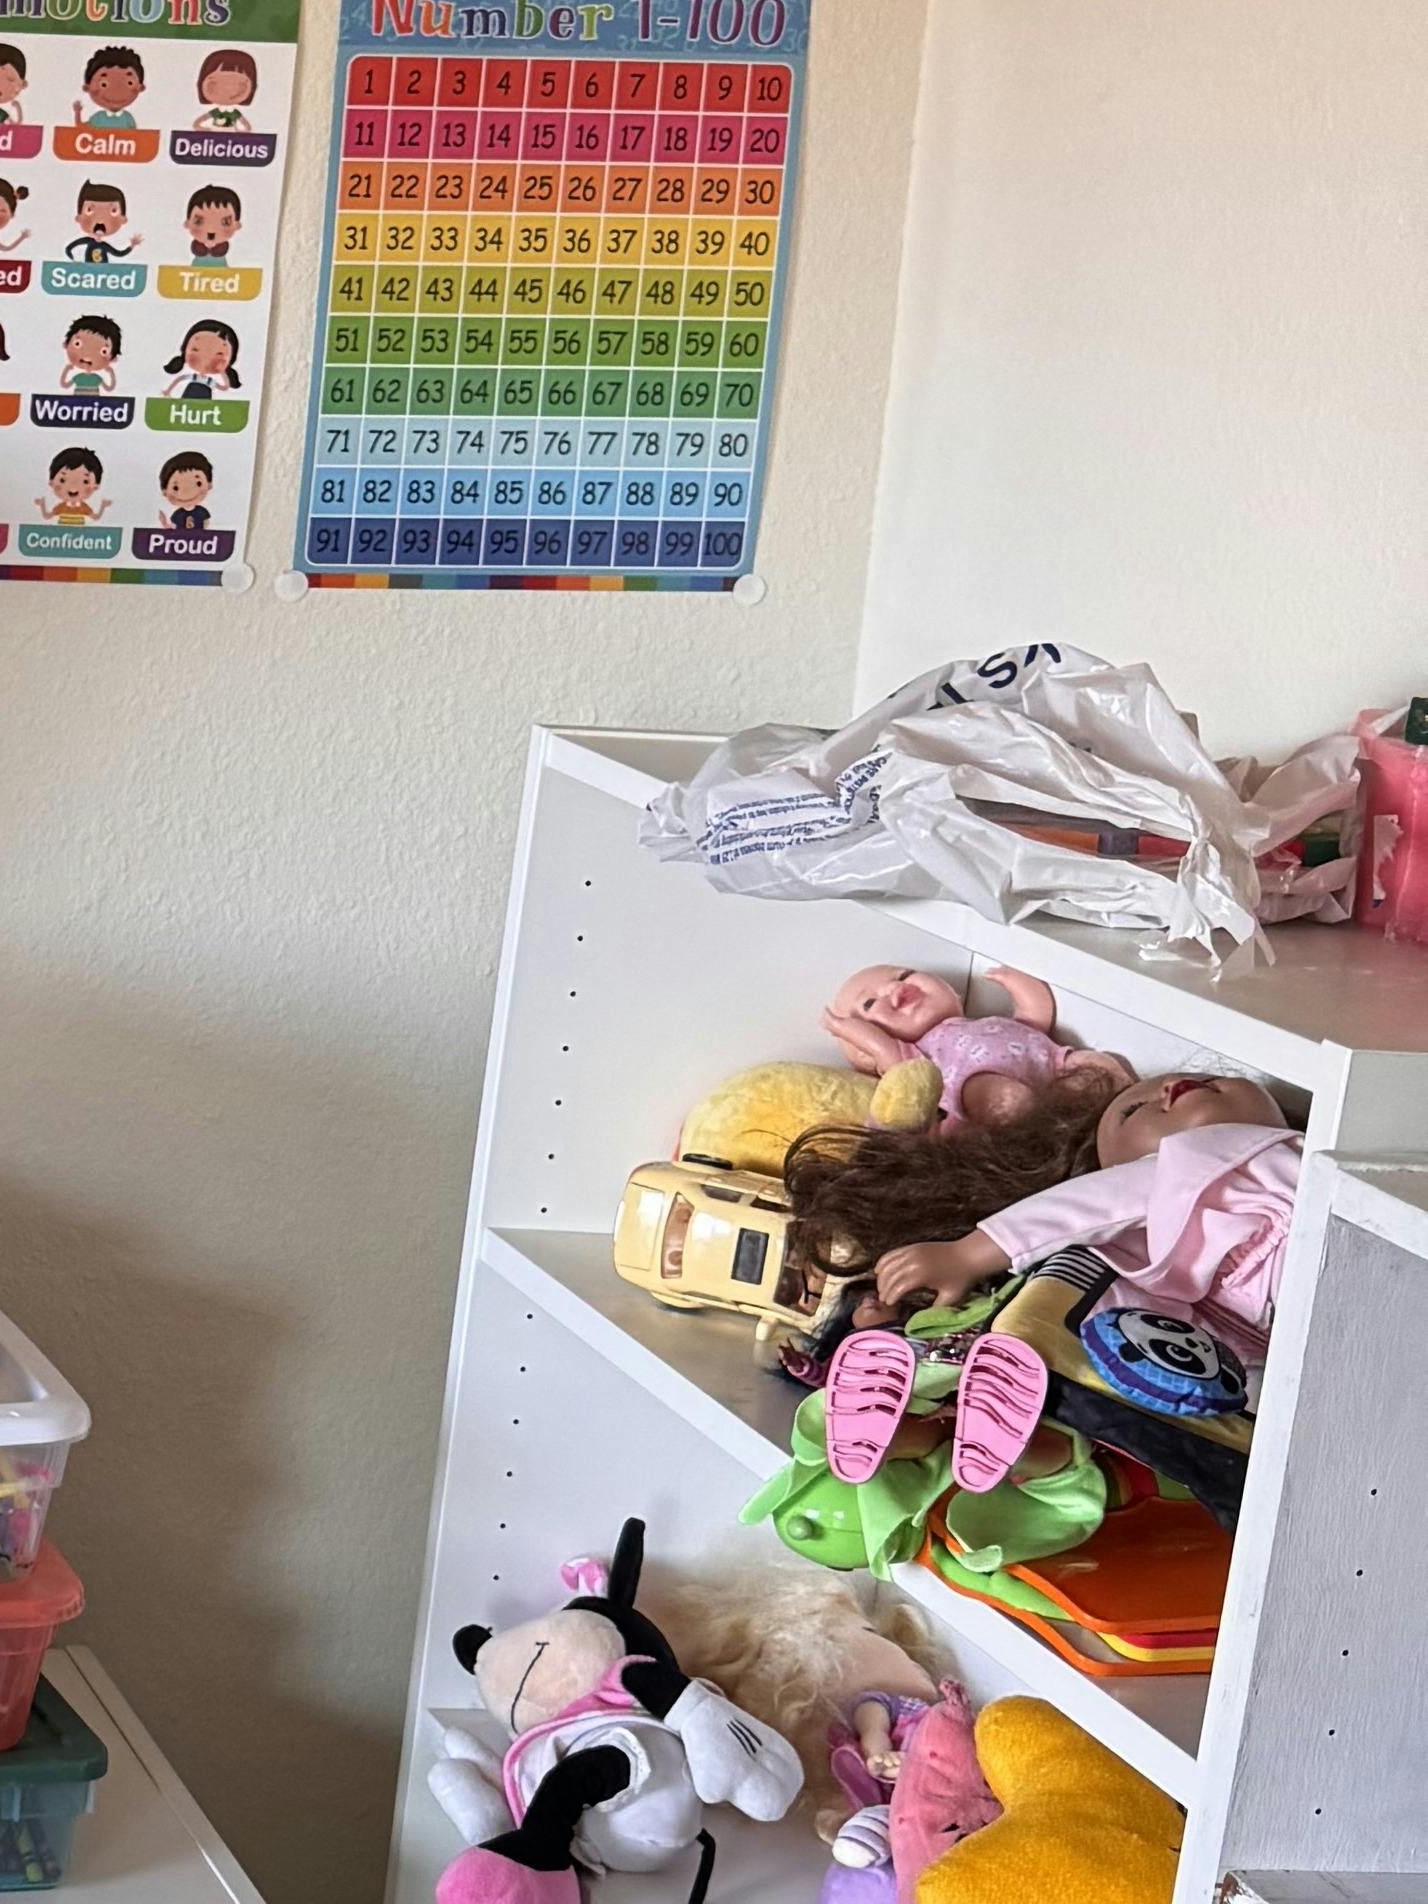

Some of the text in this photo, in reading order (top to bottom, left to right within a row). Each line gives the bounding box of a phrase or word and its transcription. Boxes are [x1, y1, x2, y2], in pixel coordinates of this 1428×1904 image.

[364, 70, 783, 101] 1 2 3 4 5 6 7 8 9 10
[75, 134, 136, 156] Calm
[175, 138, 268, 160] Delicious
[51, 269, 135, 290] Scared
[178, 272, 239, 293] Tired
[35, 401, 128, 423] Worried
[169, 405, 222, 426] Hurt
[26, 532, 112, 551] Confident
[149, 536, 217, 555] Proud
